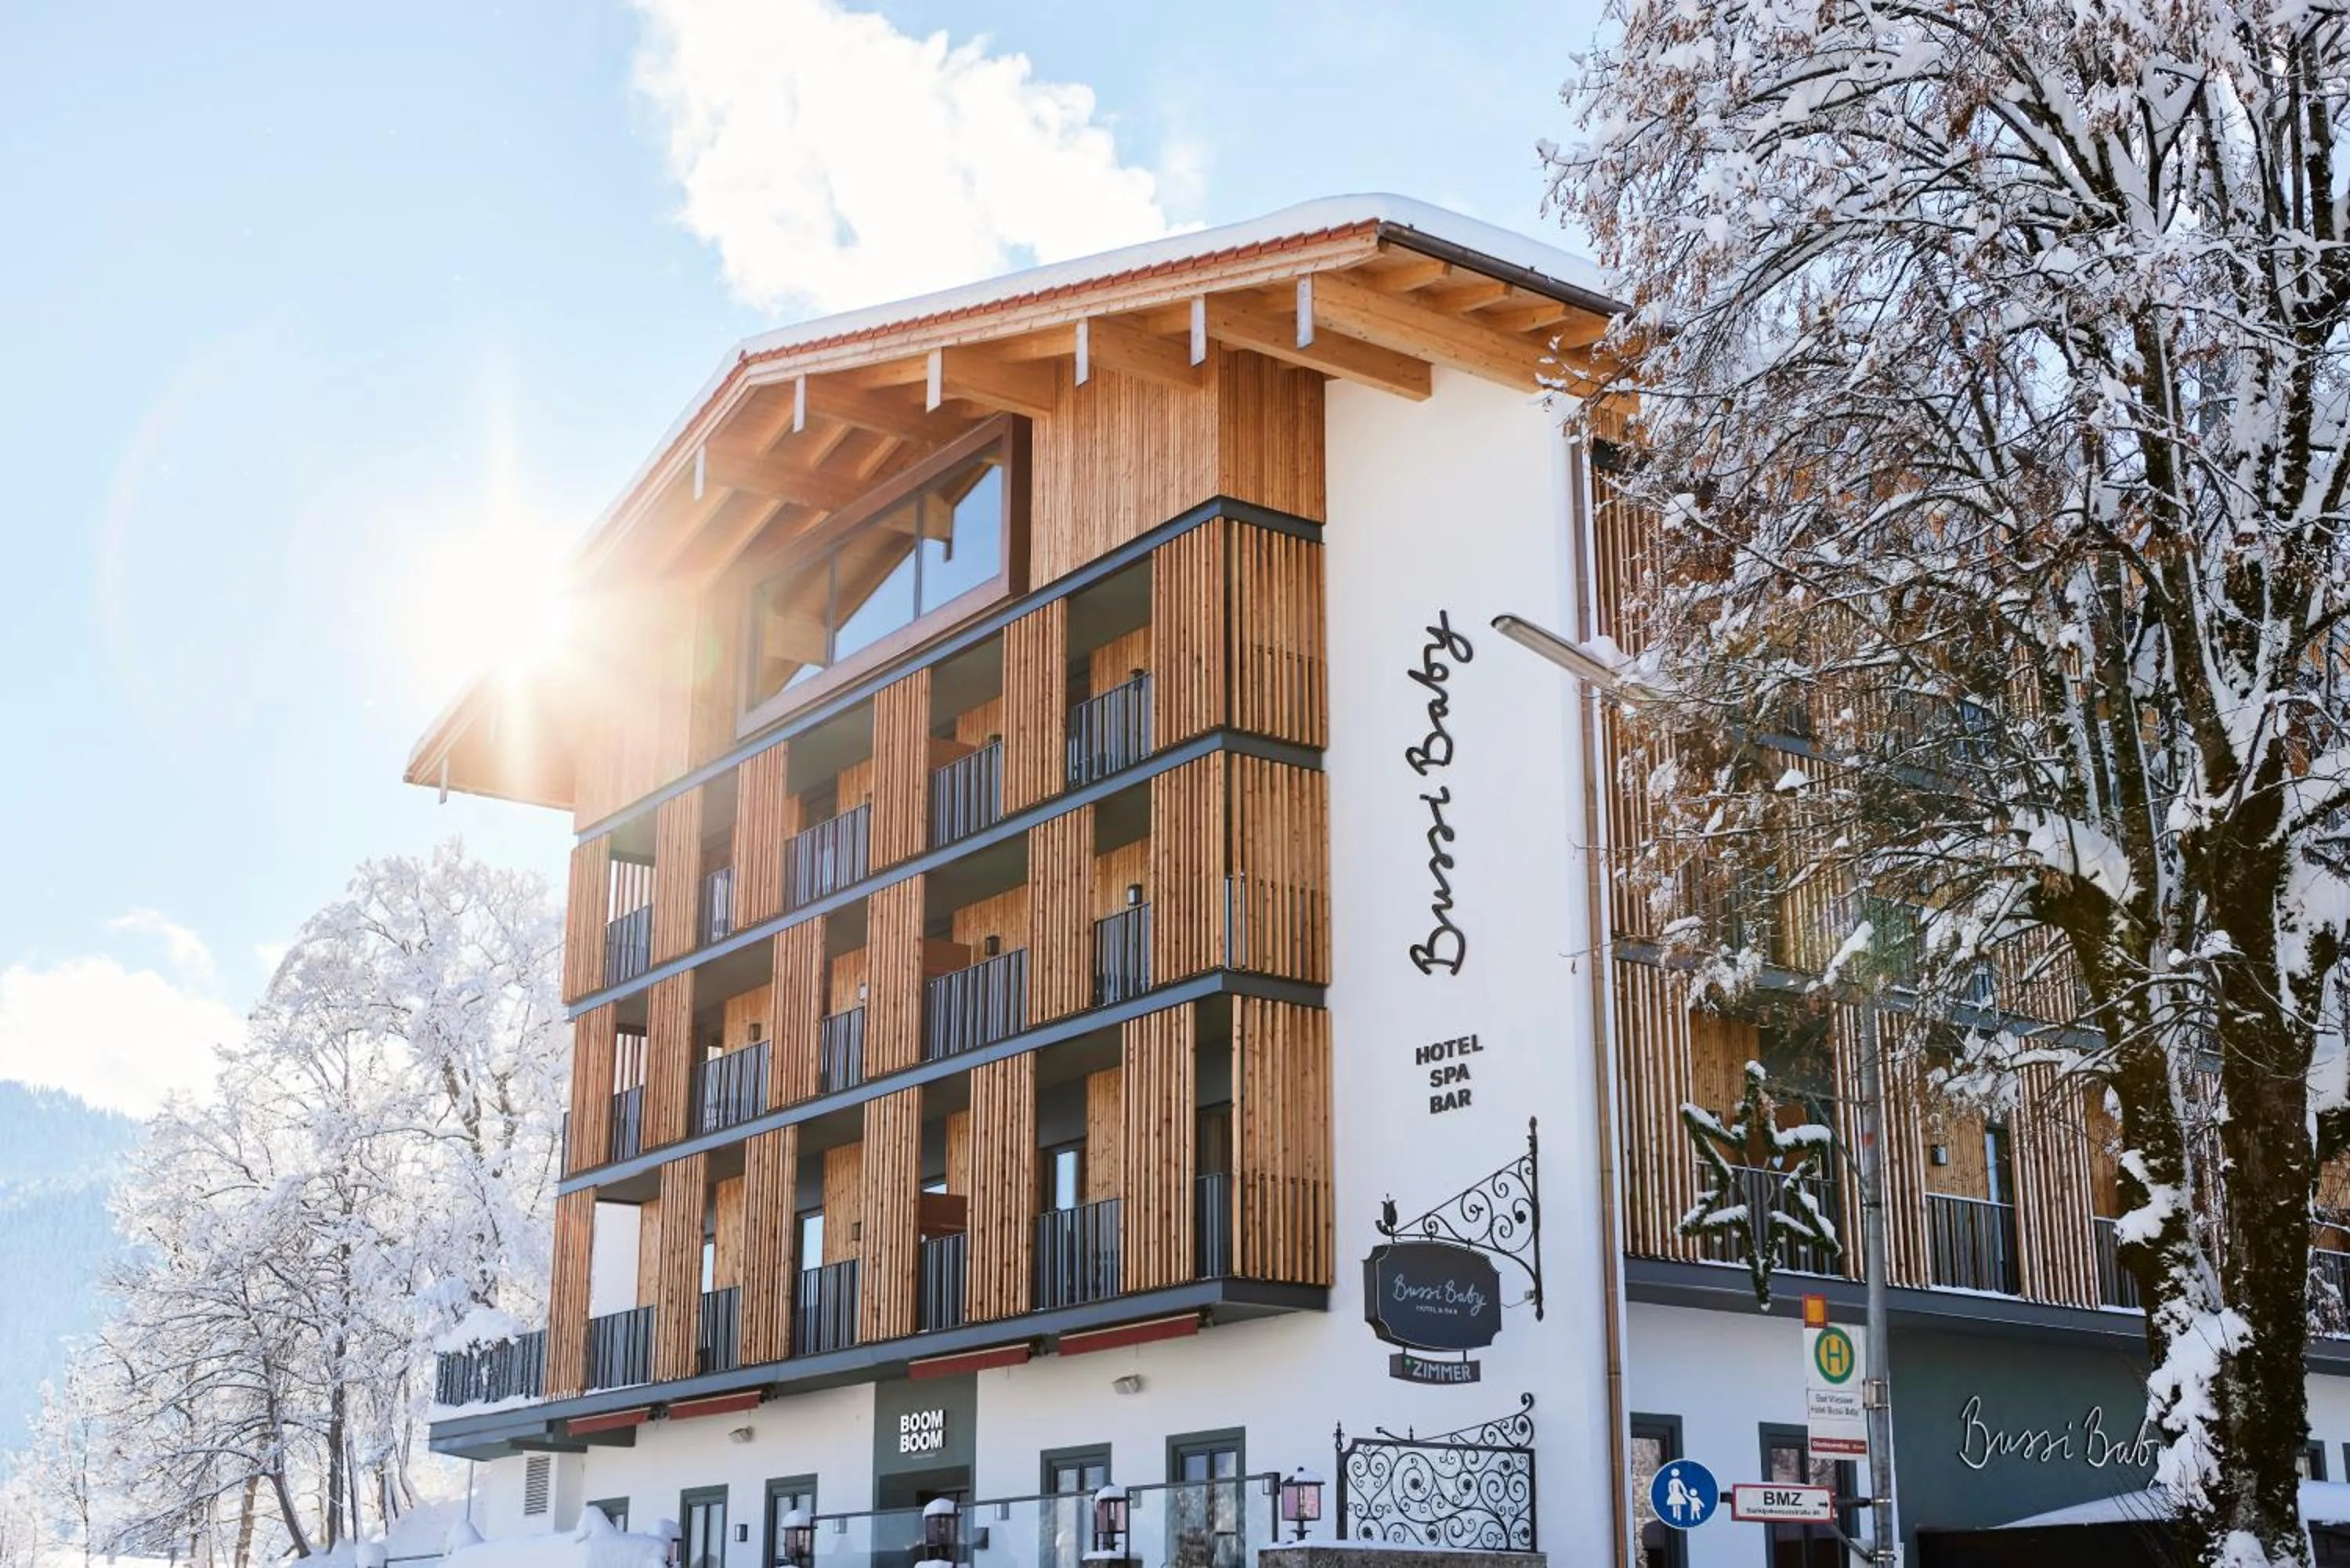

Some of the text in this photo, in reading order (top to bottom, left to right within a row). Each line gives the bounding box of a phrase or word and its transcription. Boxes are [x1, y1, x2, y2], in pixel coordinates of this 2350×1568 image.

[1405, 610, 1473, 976] Bussi Baby
[1415, 1034, 1484, 1065] HOTEL
[1430, 1063, 1471, 1088] SPA
[1430, 1089, 1472, 1114] BAR
[1393, 1273, 1487, 1317] Bussi Baby
[1827, 1339, 1843, 1372] H
[1412, 1360, 1471, 1382] ZIMMER
[900, 1409, 944, 1434] BOOM
[1959, 1396, 2074, 1469] Bussi
[899, 1429, 943, 1454] BOOM
[1763, 1490, 1802, 1506] BMZ
